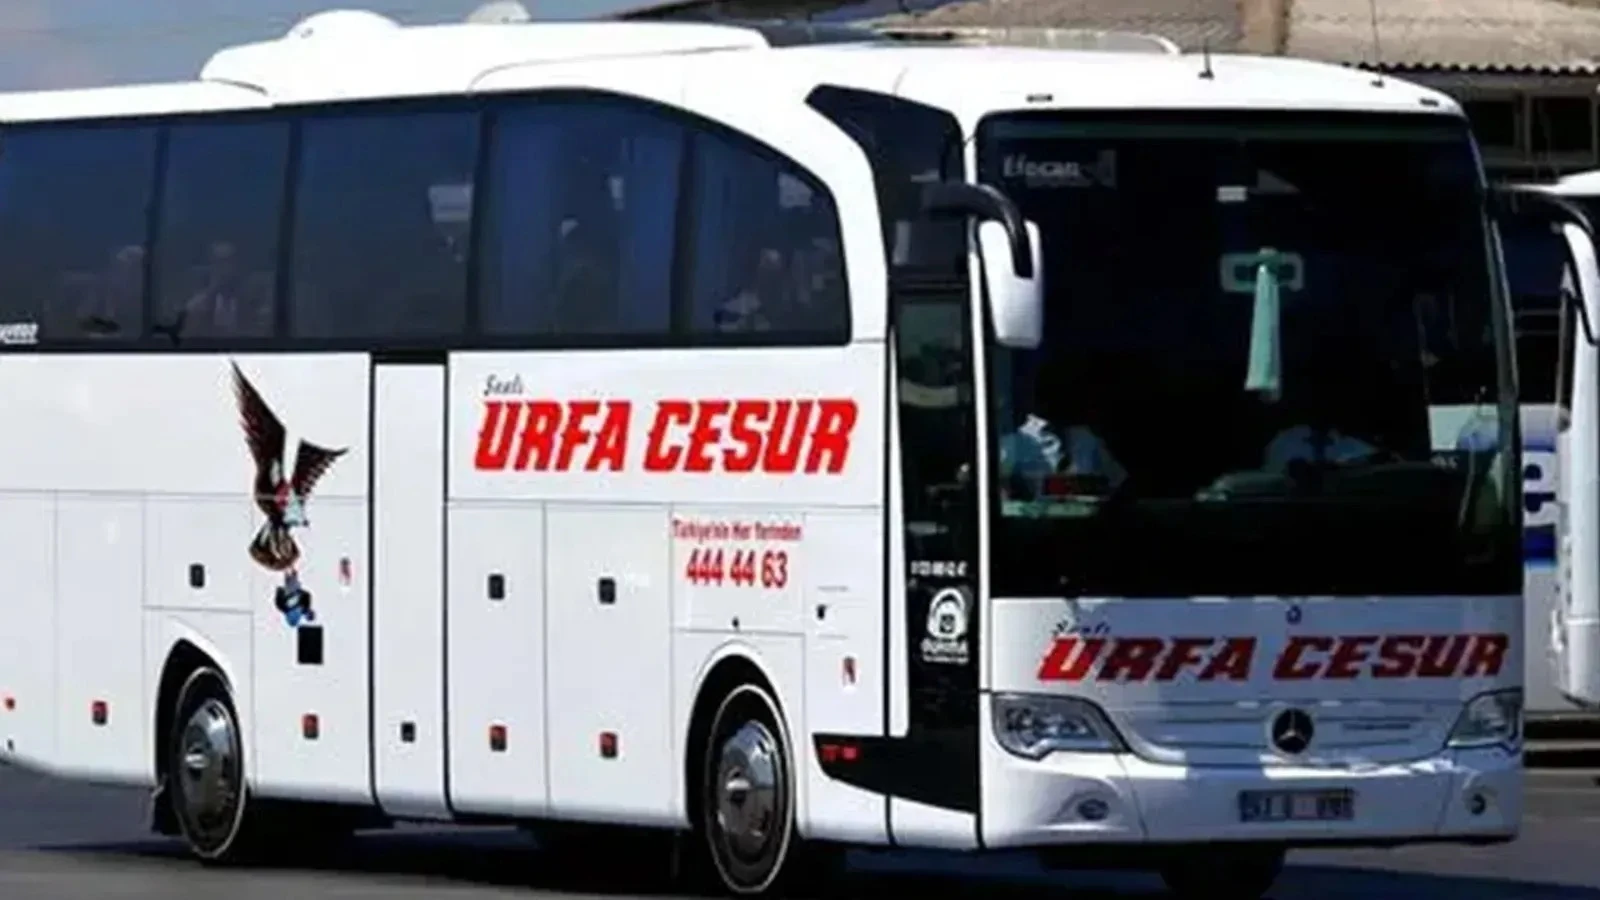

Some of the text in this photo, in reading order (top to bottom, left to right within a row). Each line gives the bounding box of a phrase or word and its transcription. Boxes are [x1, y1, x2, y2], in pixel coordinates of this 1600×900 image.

[474, 400, 858, 475] URFA CESUR
[686, 548, 788, 588] 444 44 63
[1037, 633, 1510, 682] URFA CESUR
